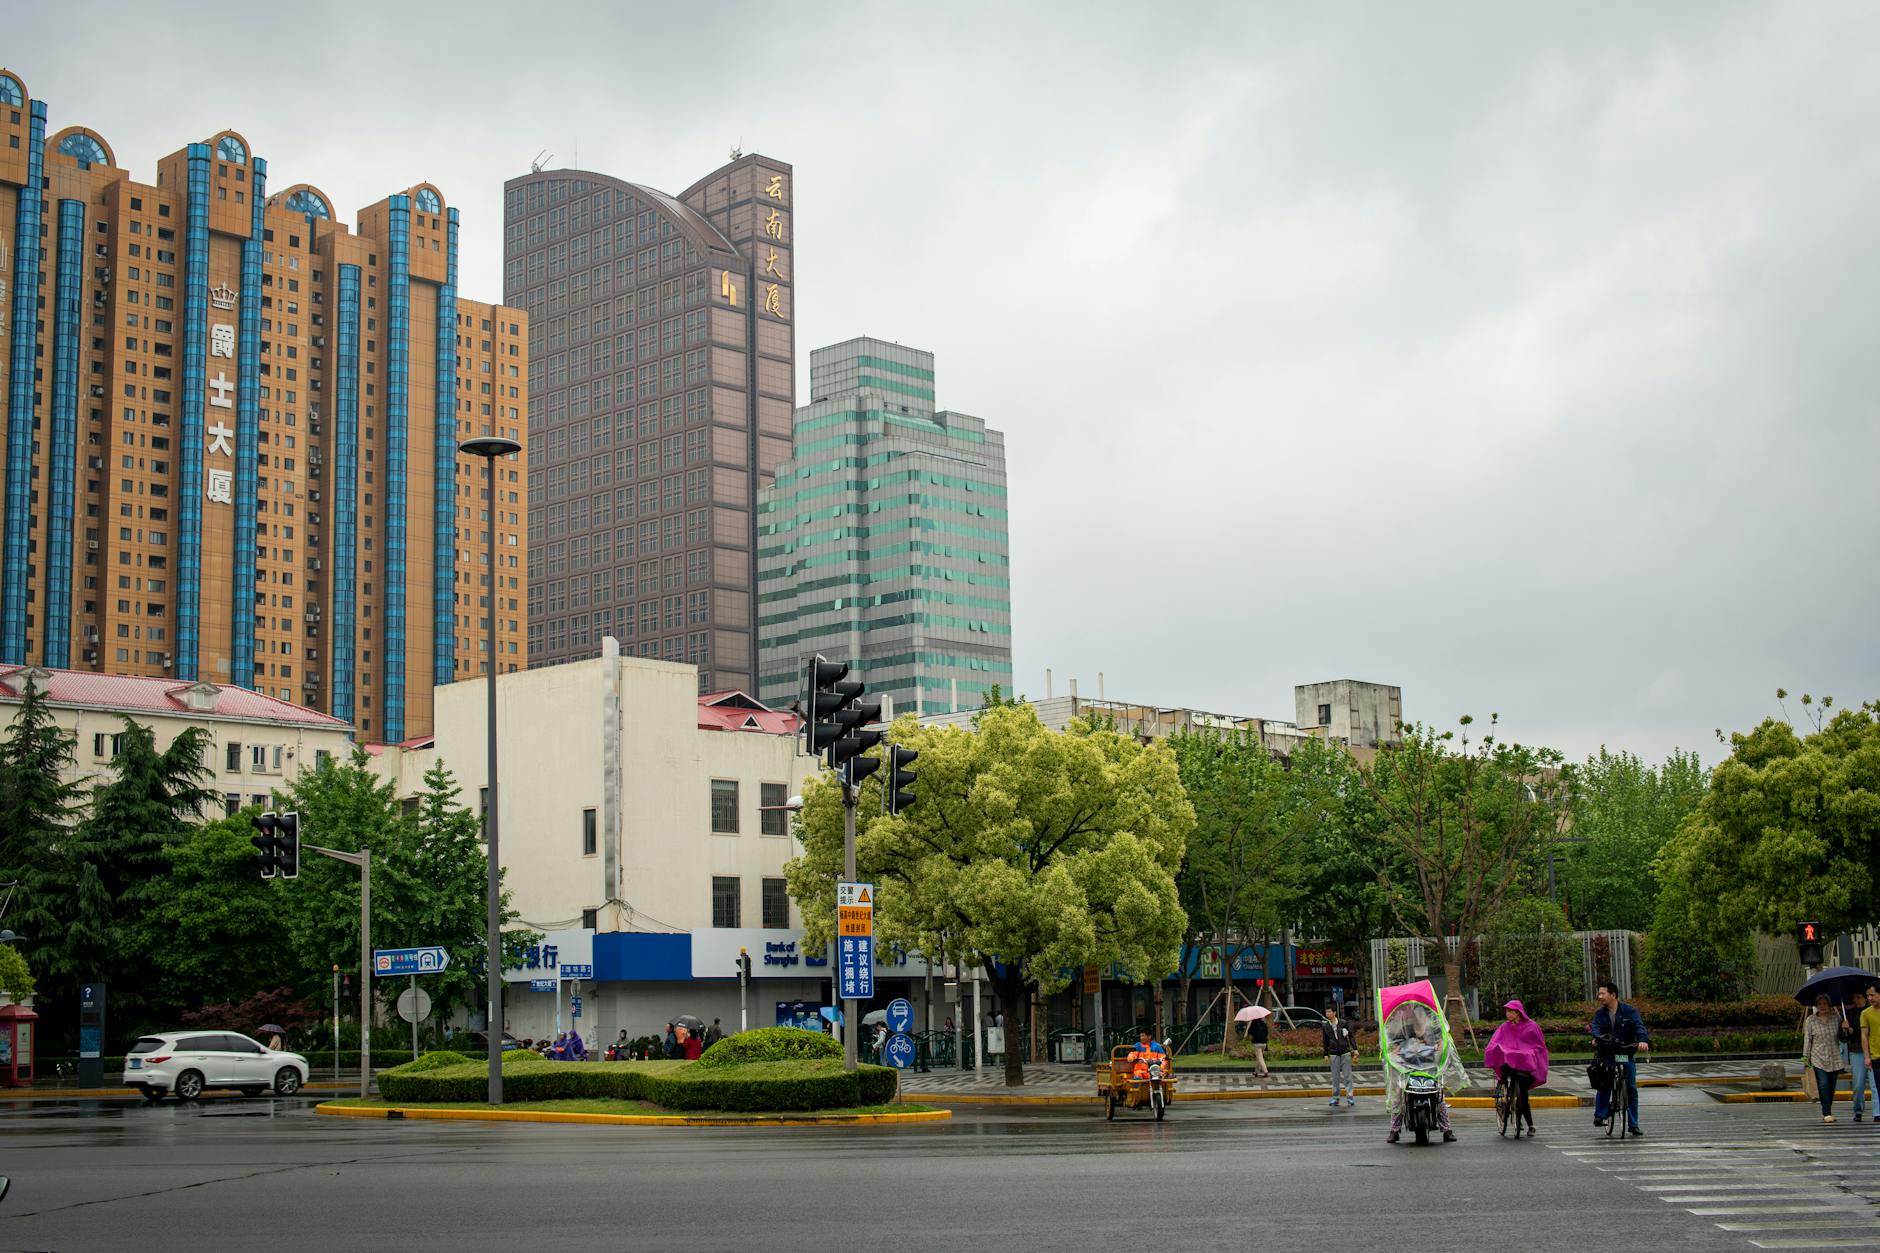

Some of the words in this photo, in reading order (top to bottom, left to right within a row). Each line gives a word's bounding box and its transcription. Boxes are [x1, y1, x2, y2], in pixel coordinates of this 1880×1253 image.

[765, 176, 784, 318] 云南大厦
[206, 323, 235, 505] 爵士大厦
[840, 886, 854, 895] 交警
[764, 953, 799, 967] Shanghai
[766, 941, 786, 953] Bank
[787, 941, 795, 953] of
[843, 939, 855, 994] 施工拥堵
[858, 940, 869, 994] 建议绕行
